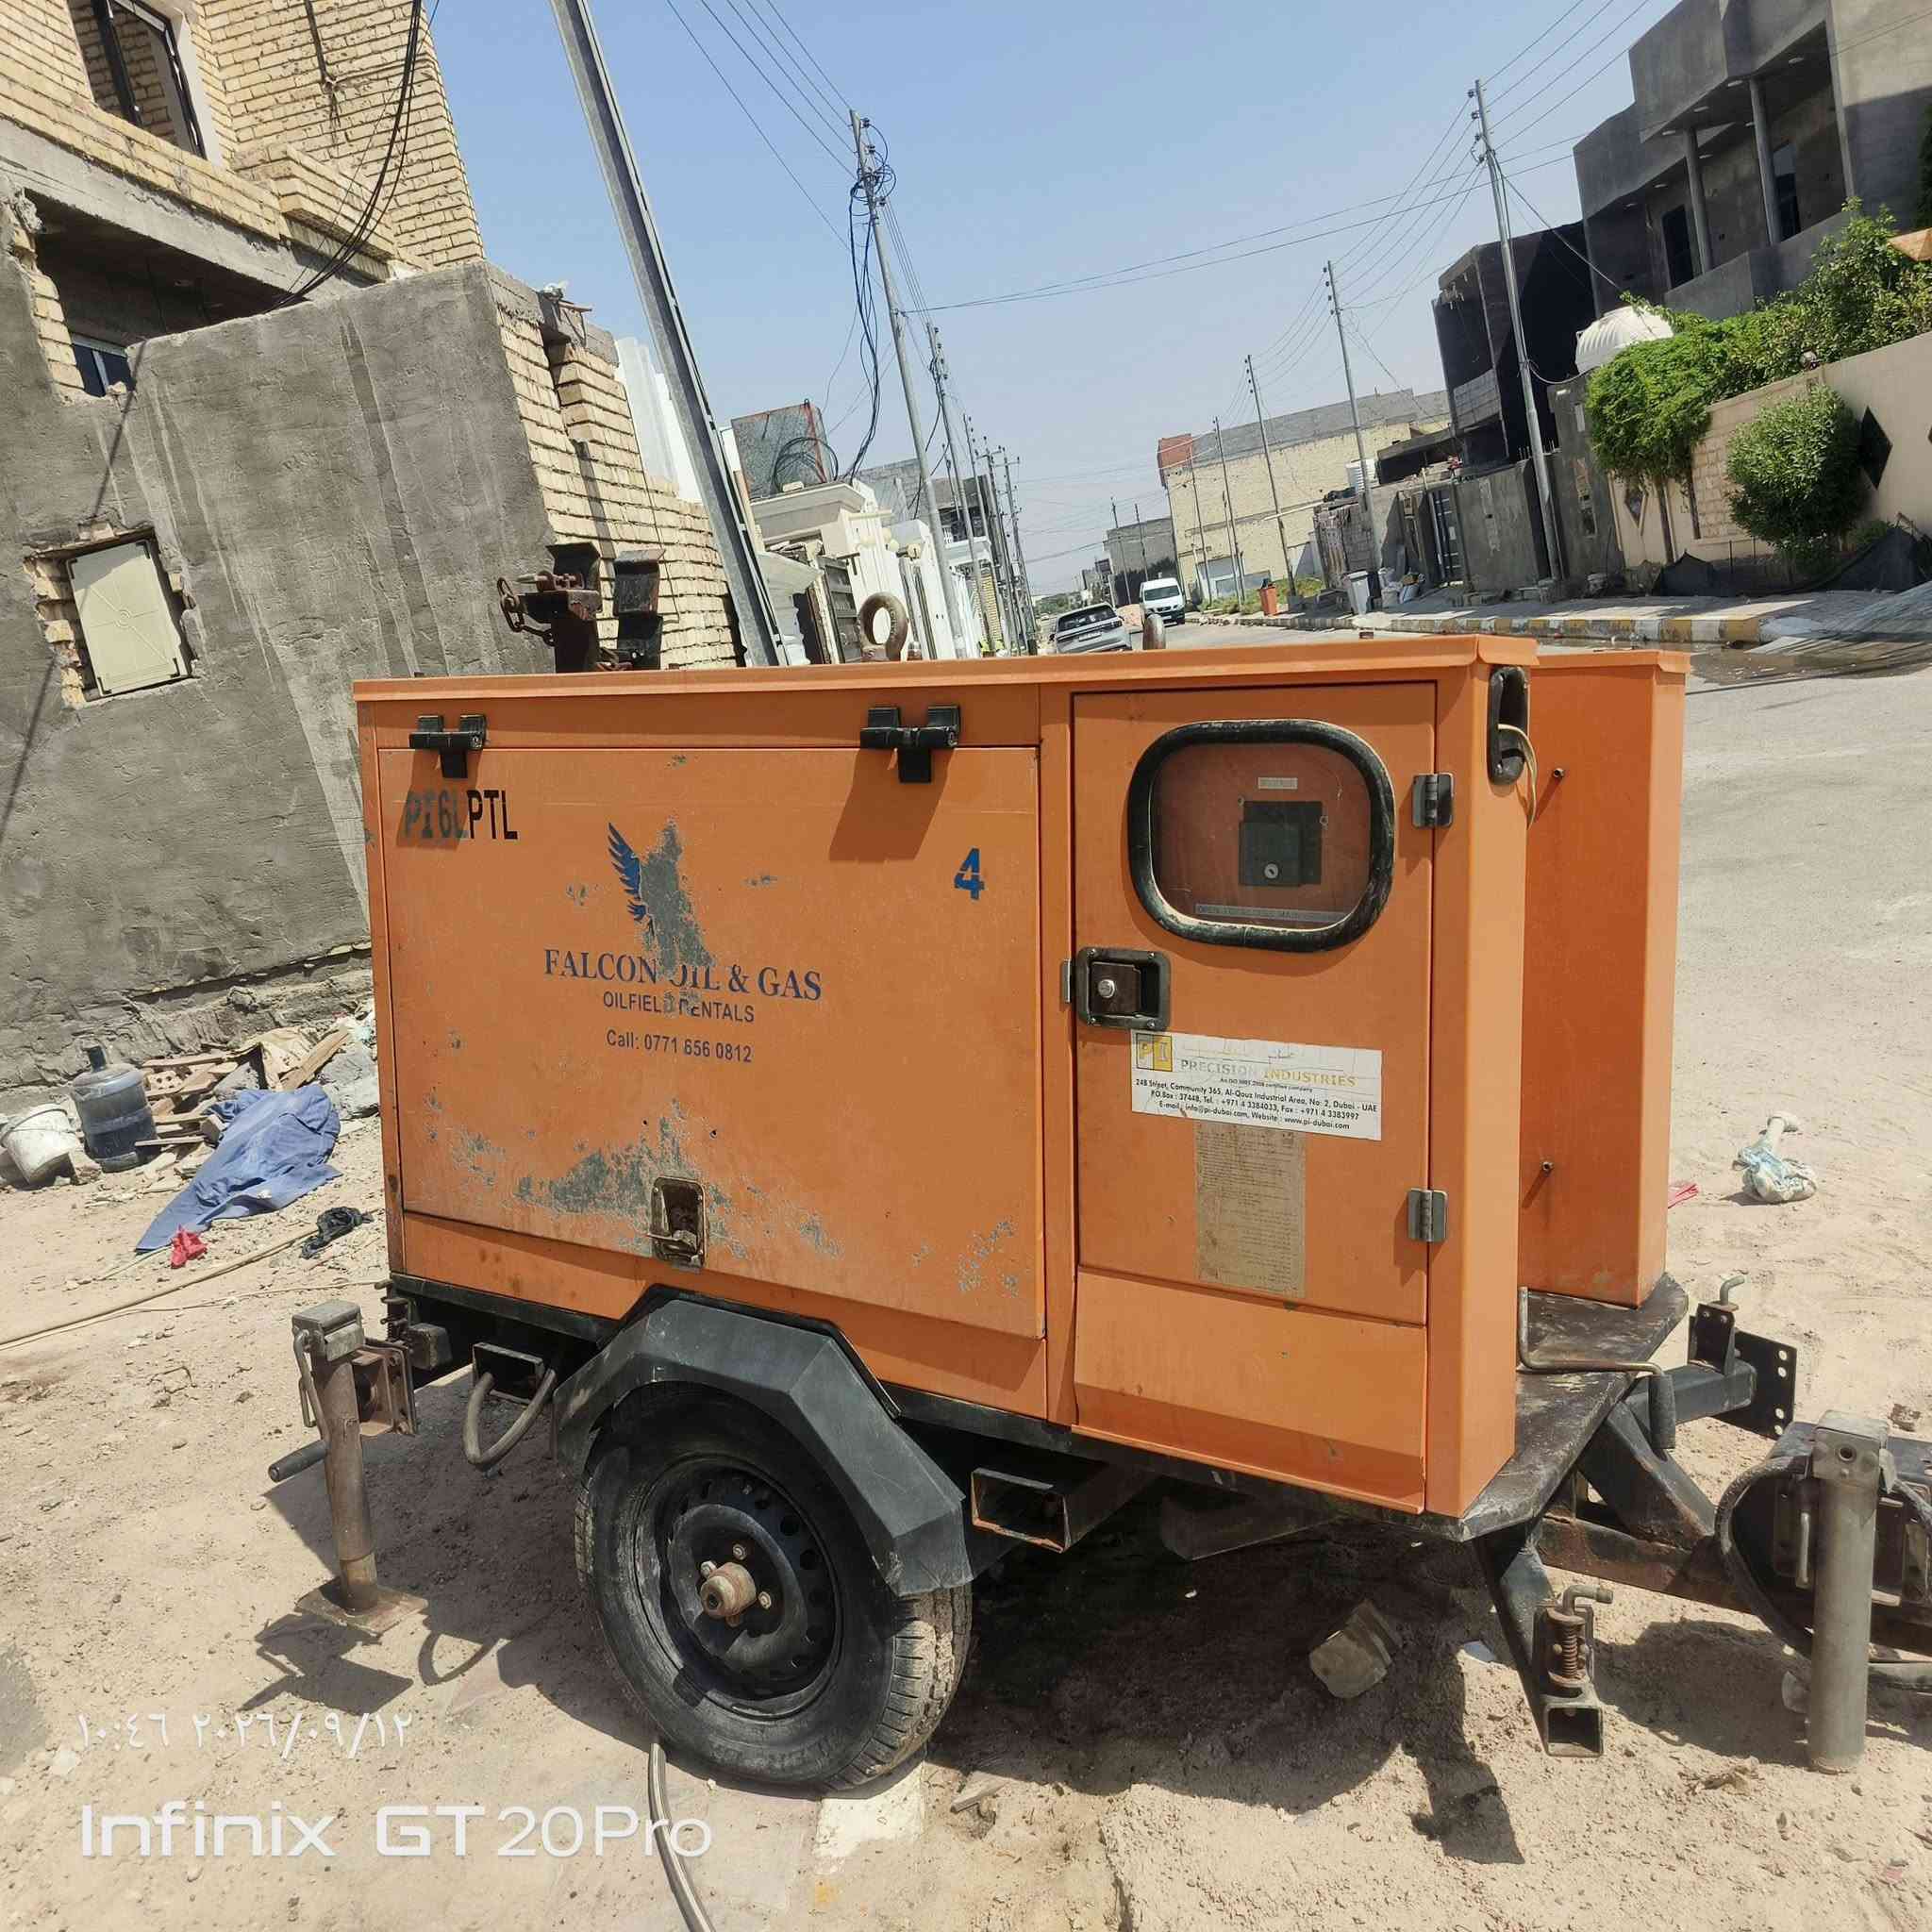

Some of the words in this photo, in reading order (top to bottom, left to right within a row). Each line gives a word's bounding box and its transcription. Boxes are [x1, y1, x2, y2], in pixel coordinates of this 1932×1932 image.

[953, 847, 985, 900] 4
[543, 948, 659, 985] FALCON
[727, 963, 751, 994] &
[758, 965, 823, 1002] GAS
[606, 1028, 640, 1050] Call:
[644, 1034, 678, 1054] 0771
[684, 1039, 710, 1058] 656
[715, 1041, 753, 1063] 0812
[1170, 1082, 1208, 1095] Community
[1254, 1091, 1287, 1104] Industrial
[1333, 1100, 1356, 1110] Dubai
[1361, 1102, 1378, 1113] UAE
[1281, 1105, 1293, 1114] Fax
